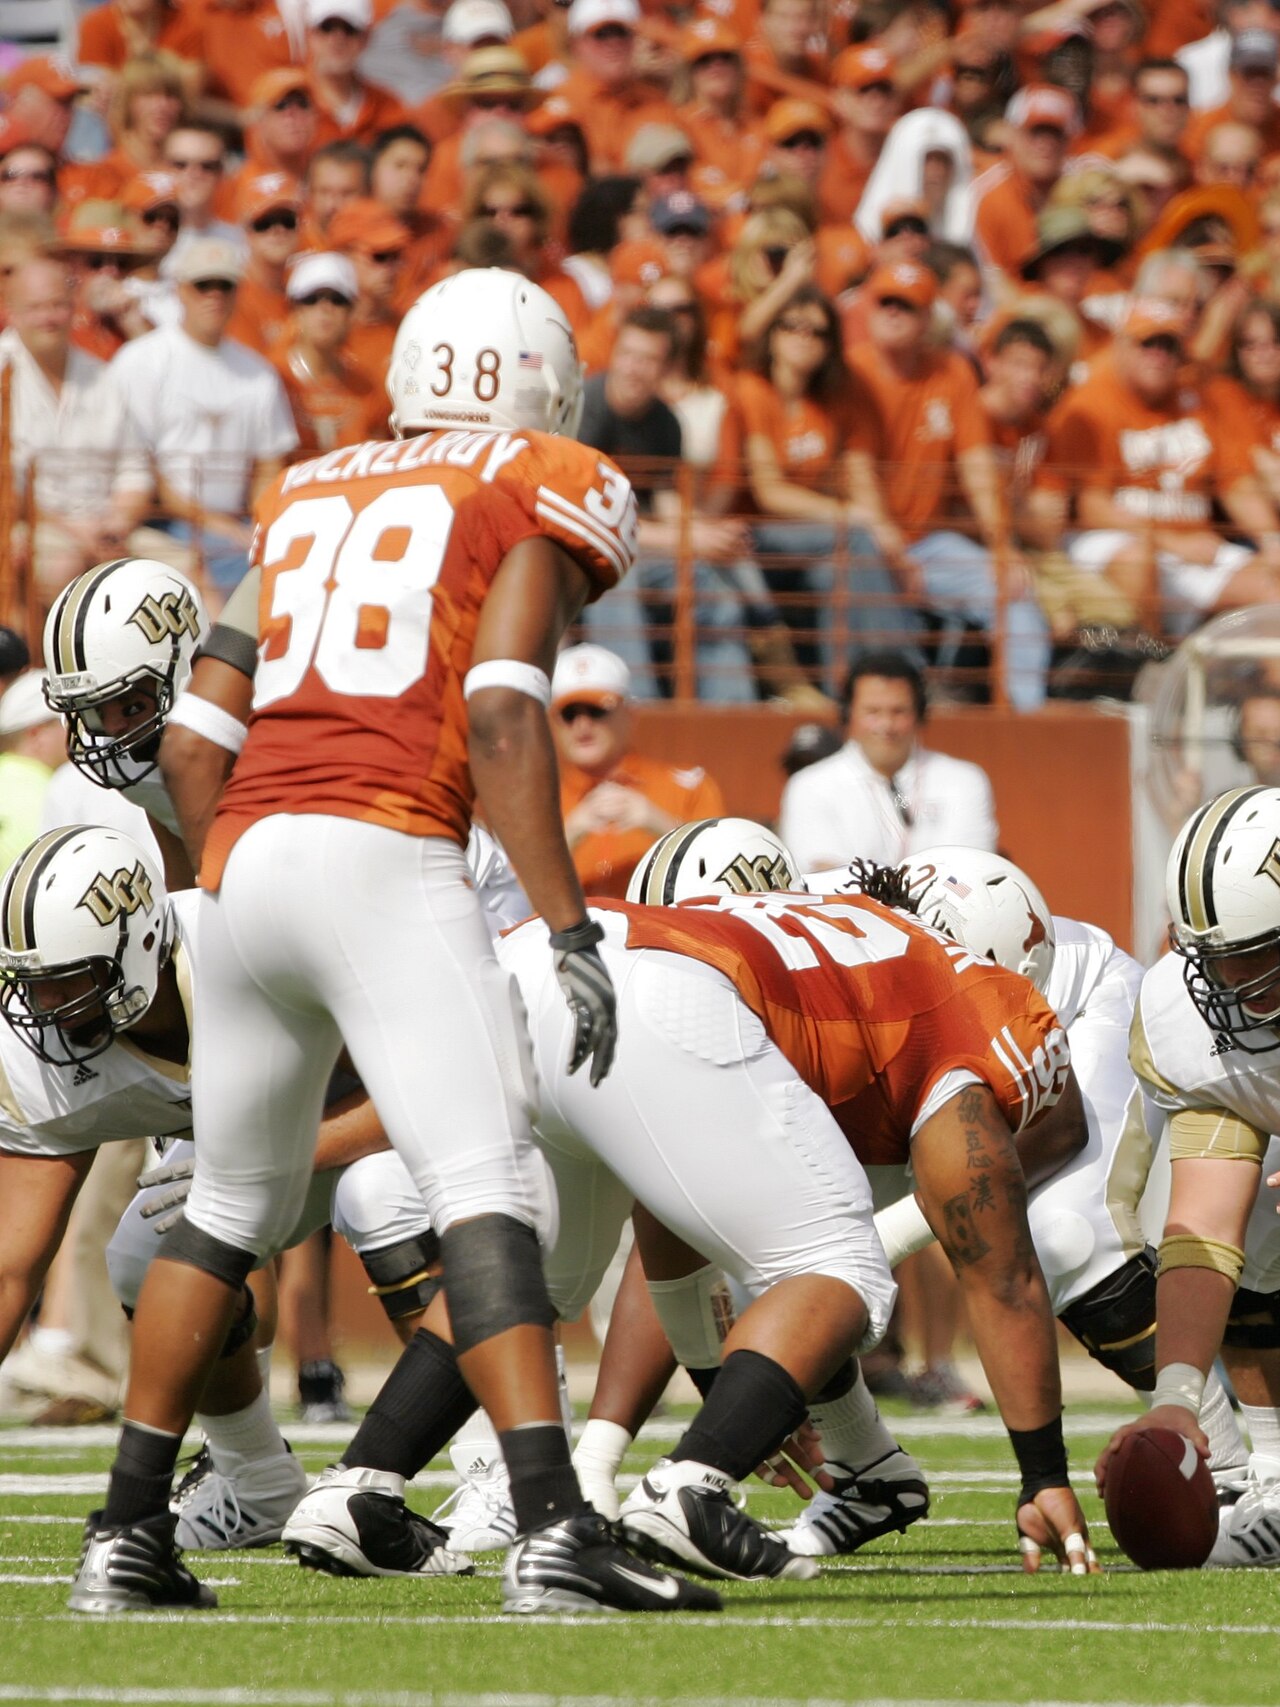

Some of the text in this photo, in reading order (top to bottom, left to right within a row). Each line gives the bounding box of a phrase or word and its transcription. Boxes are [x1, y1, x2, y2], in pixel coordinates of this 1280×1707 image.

[430, 342, 501, 402] 38
[124, 585, 201, 643] UCF
[252, 484, 455, 711] 38
[73, 858, 155, 927] UCF
[712, 853, 793, 894] UCF
[702, 1471, 728, 1489] NIKE
